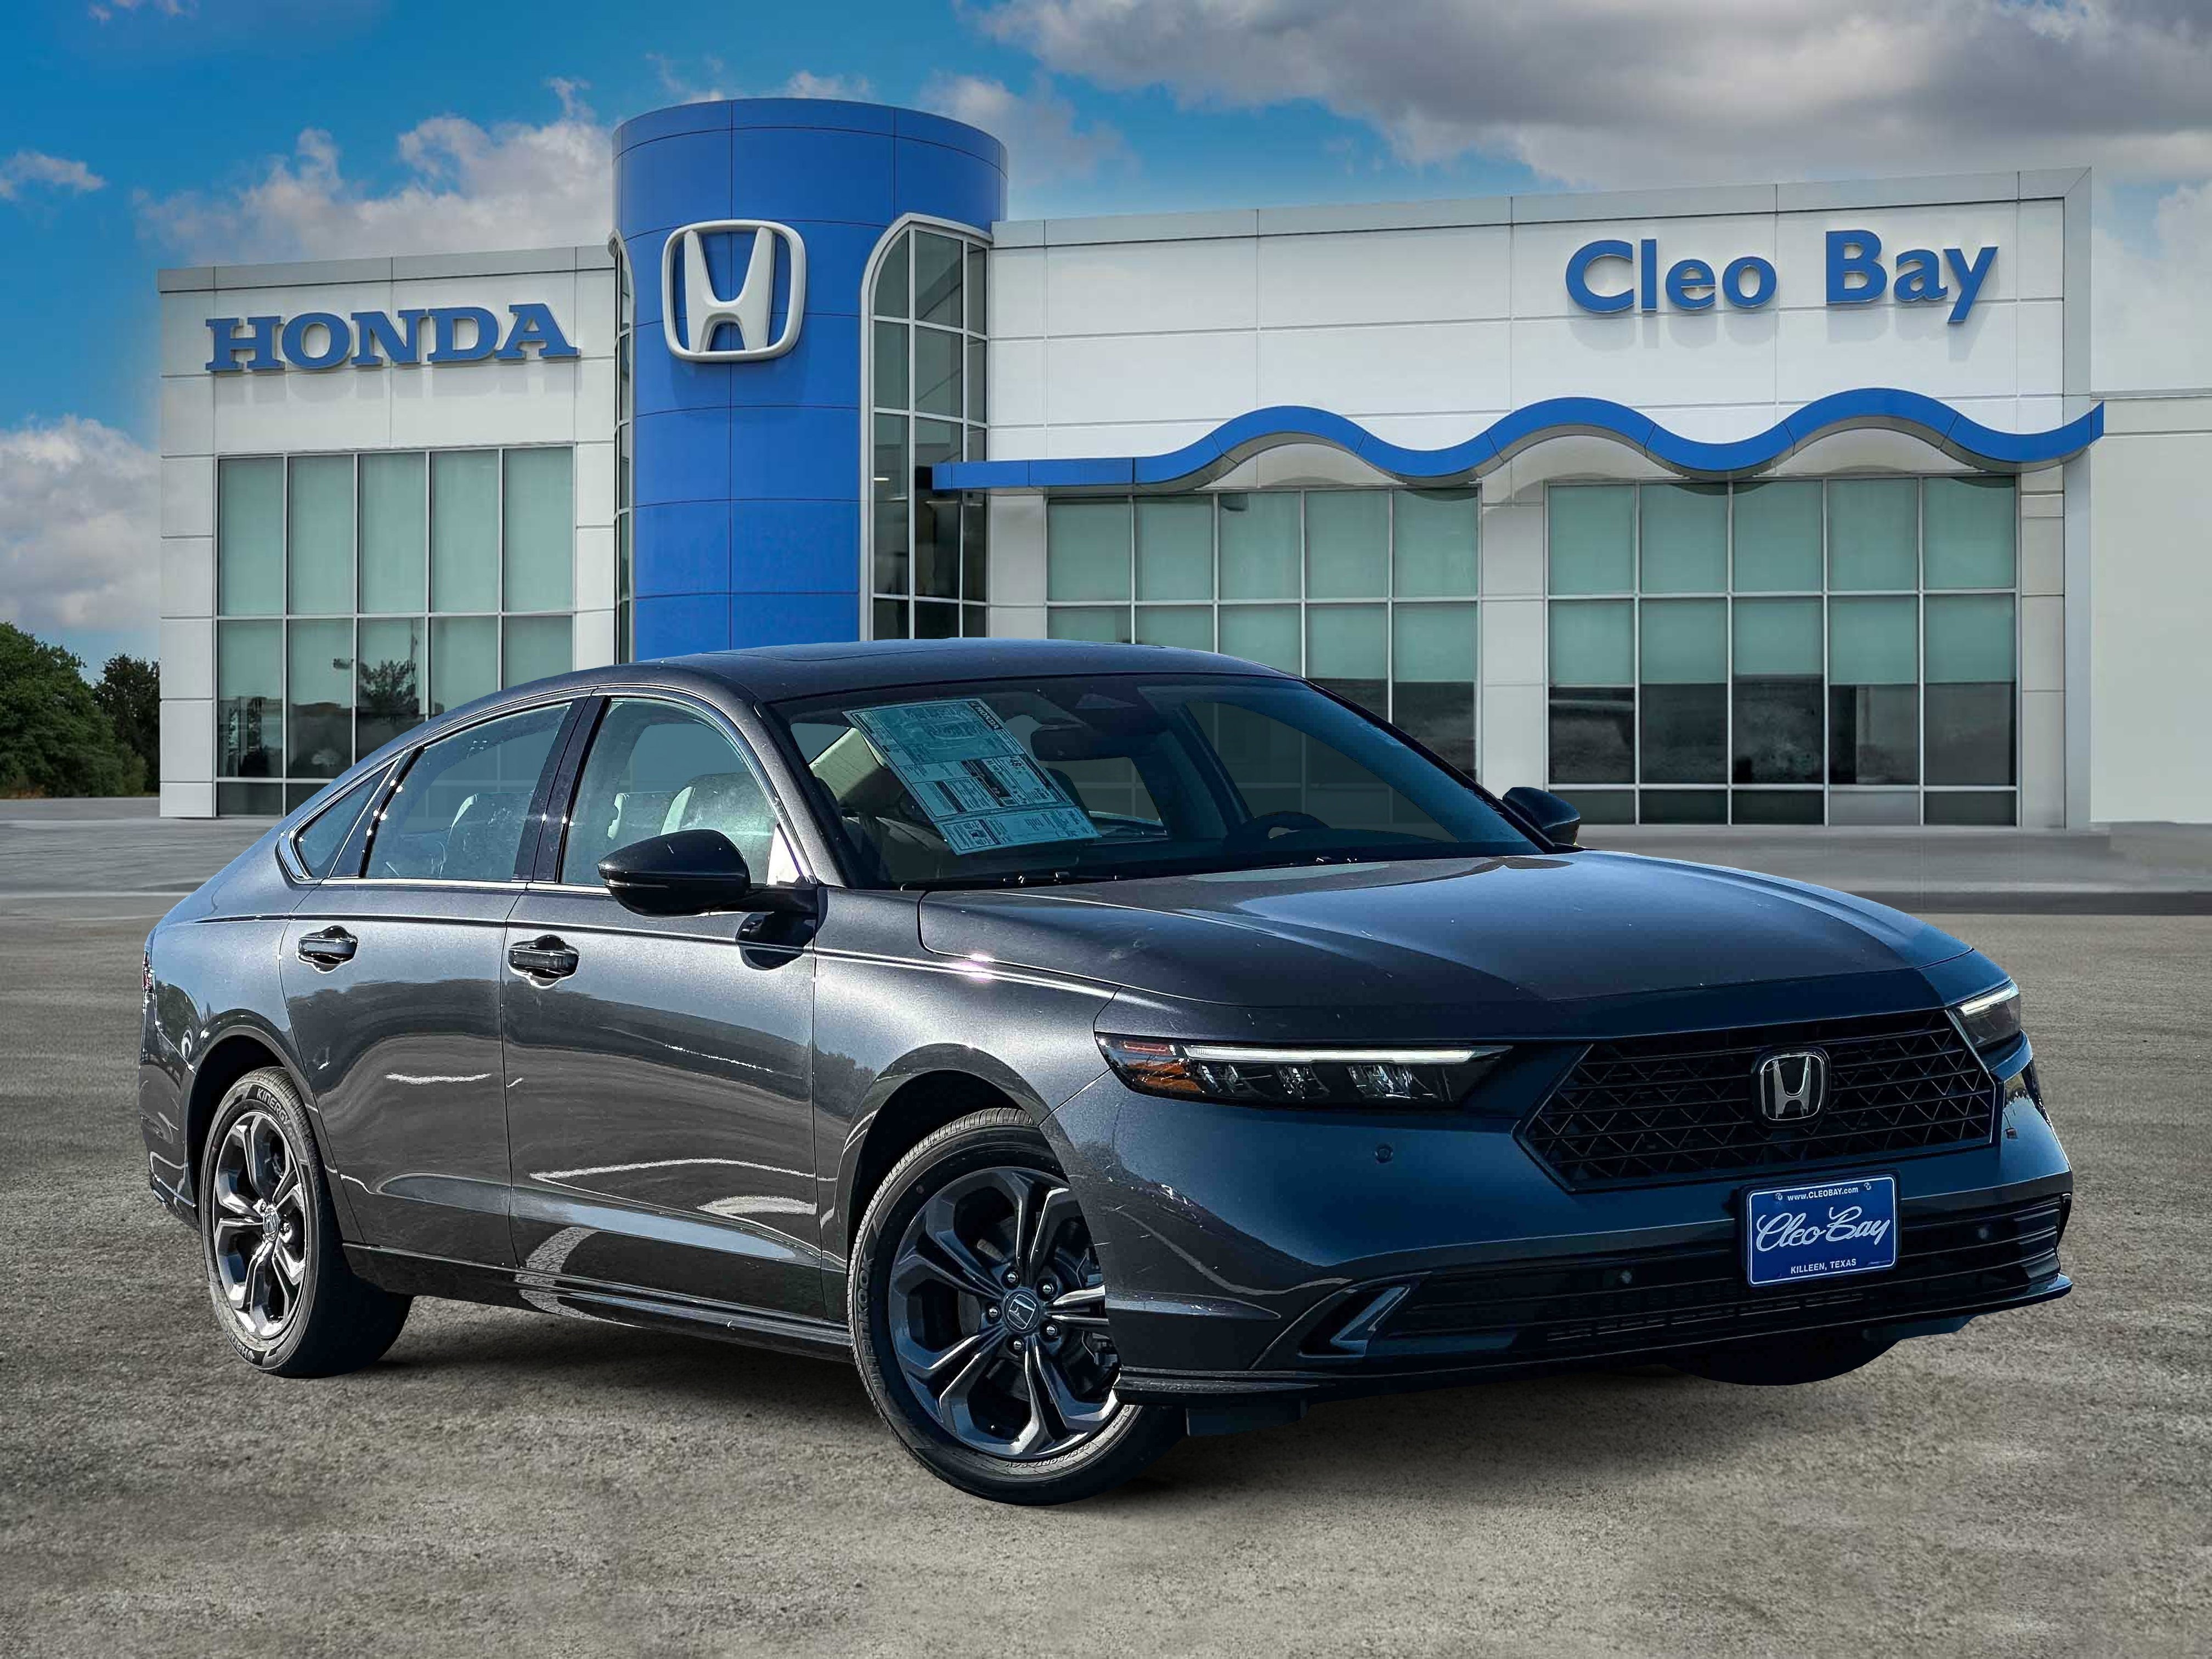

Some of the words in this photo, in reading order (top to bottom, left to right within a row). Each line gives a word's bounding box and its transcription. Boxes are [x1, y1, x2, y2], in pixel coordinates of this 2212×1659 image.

[1565, 238, 1778, 313] Cleo
[1825, 229, 1999, 324] Bay
[205, 303, 582, 373] HONDA
[1787, 1187, 1859, 1201] www.CLEOBAY.com
[1756, 1212, 1826, 1252] Cleo
[1825, 1206, 1891, 1245] Bay
[1790, 1262, 1827, 1274] KILLEEN,
[1830, 1258, 1857, 1269] TEXAS
